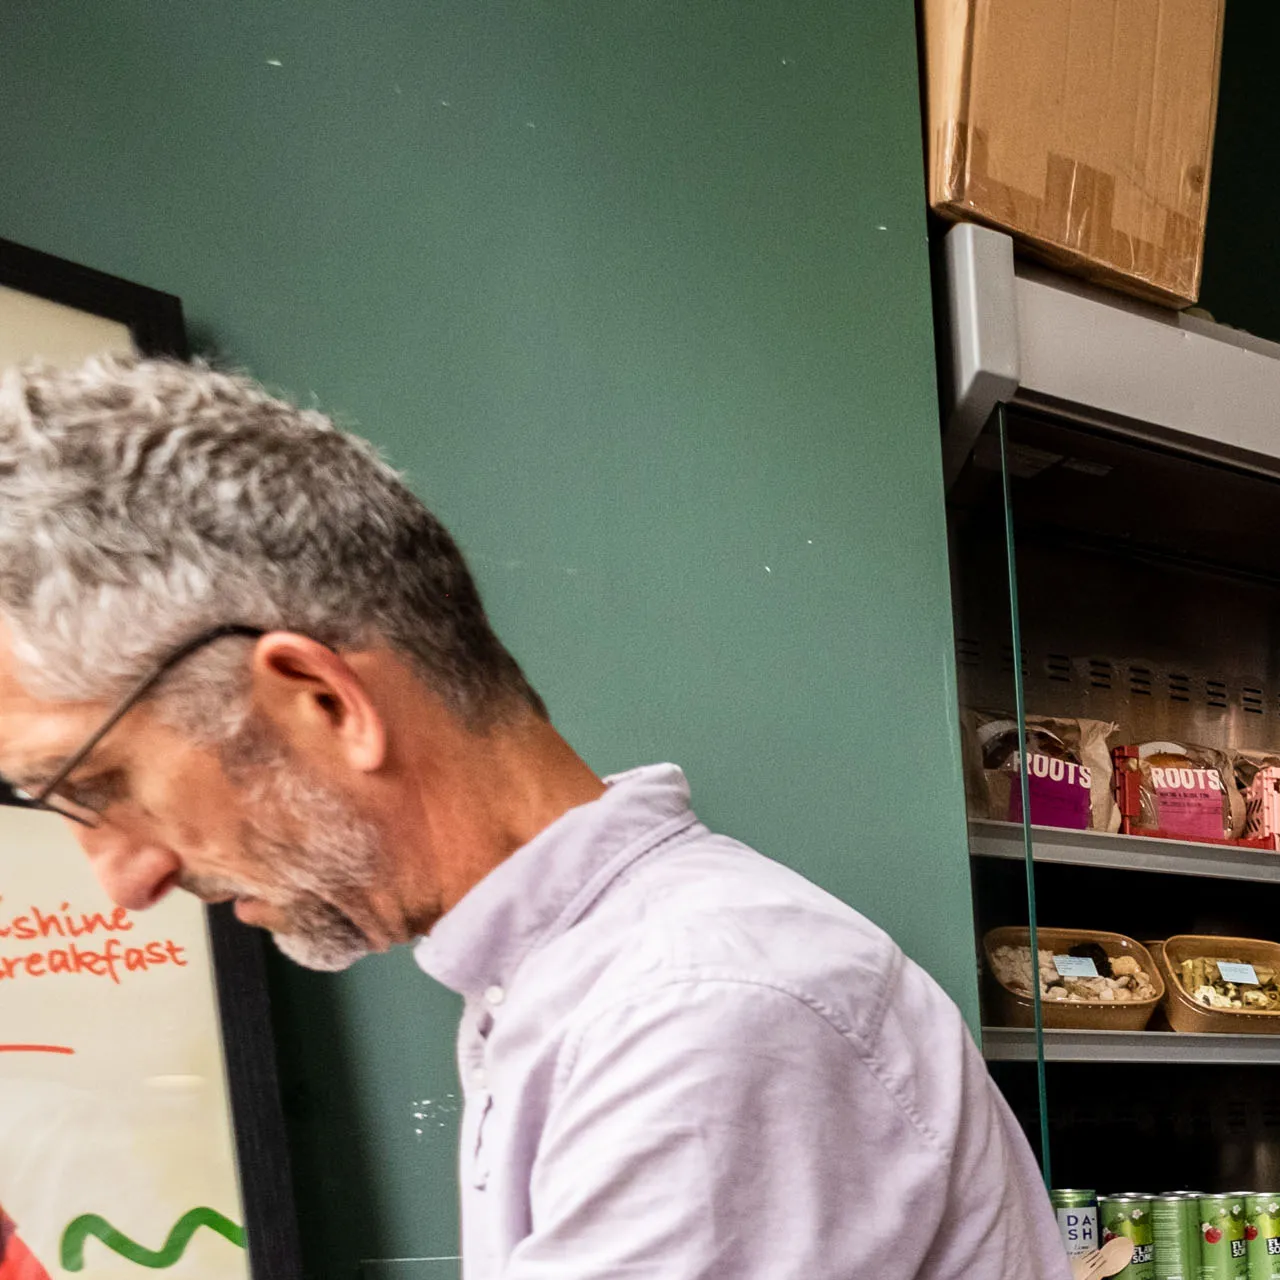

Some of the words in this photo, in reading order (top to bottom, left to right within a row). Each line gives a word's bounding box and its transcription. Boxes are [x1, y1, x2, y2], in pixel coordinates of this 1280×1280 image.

[1013, 750, 1092, 789] ROOTS
[1151, 767, 1221, 791] ROOTS
[0, 902, 134, 940] shine
[0, 938, 189, 985] reakfast
[1068, 1228, 1092, 1240] SH
